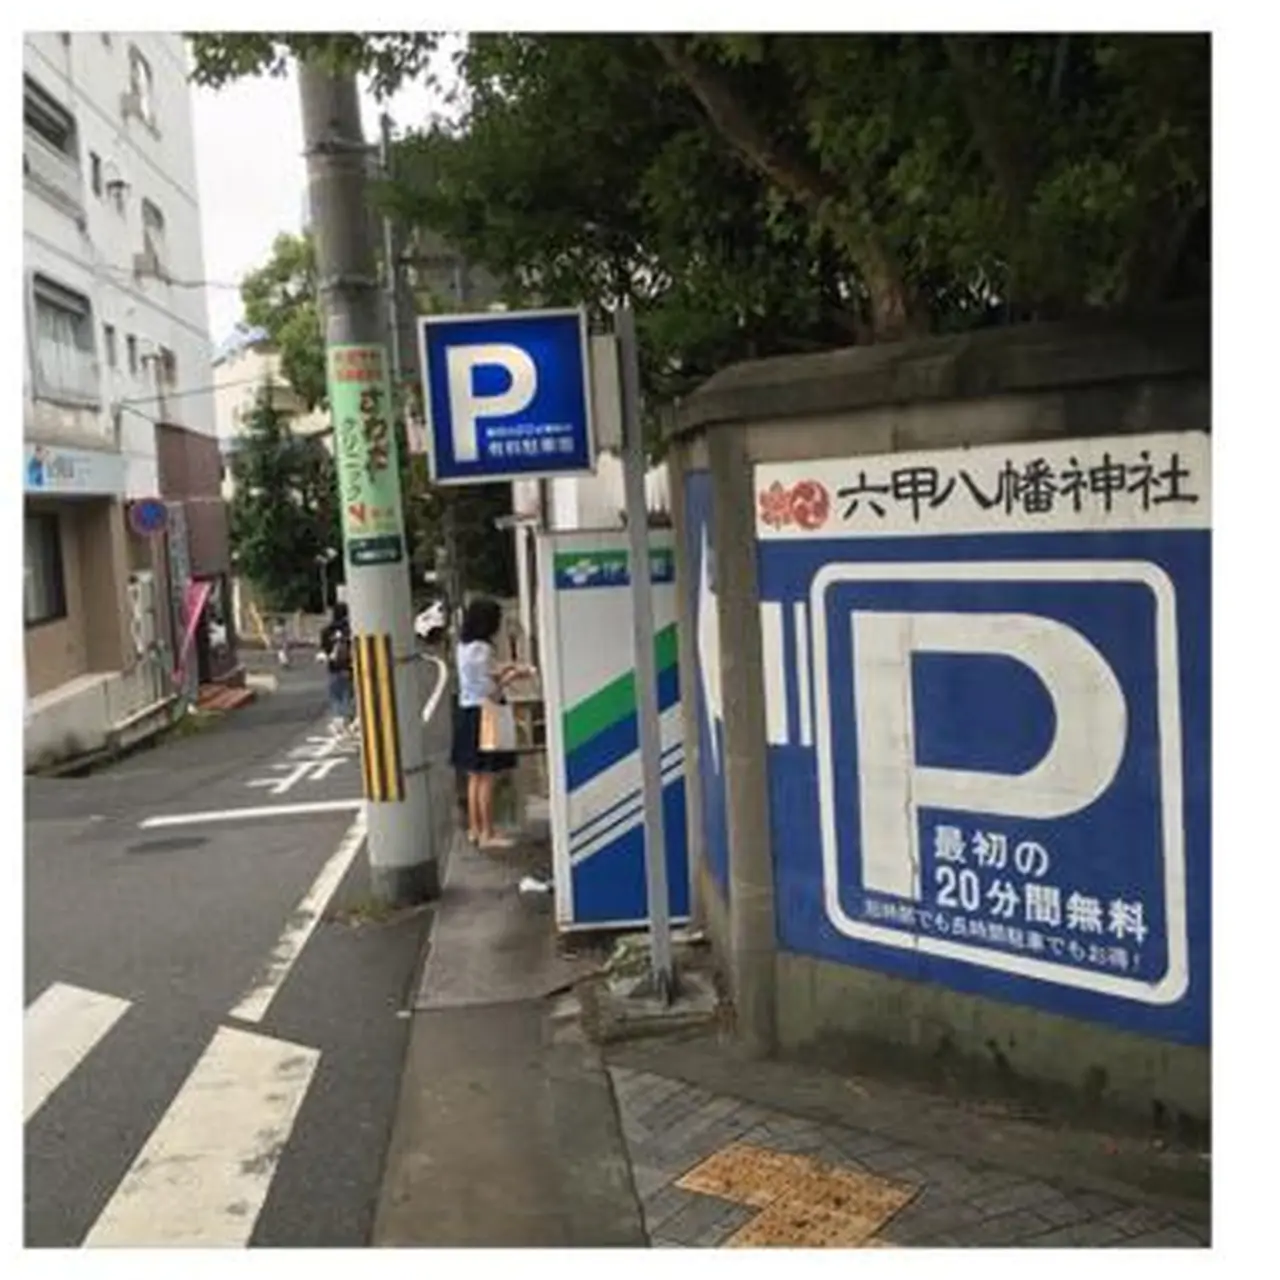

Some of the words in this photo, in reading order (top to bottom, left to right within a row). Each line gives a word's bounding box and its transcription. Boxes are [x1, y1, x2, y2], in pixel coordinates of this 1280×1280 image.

[445, 343, 538, 462] P
[837, 450, 1199, 521] 六甲八幡神社
[851, 609, 1129, 902] P
[934, 824, 1050, 877] 最初の
[935, 866, 1149, 944] 20分間無料
